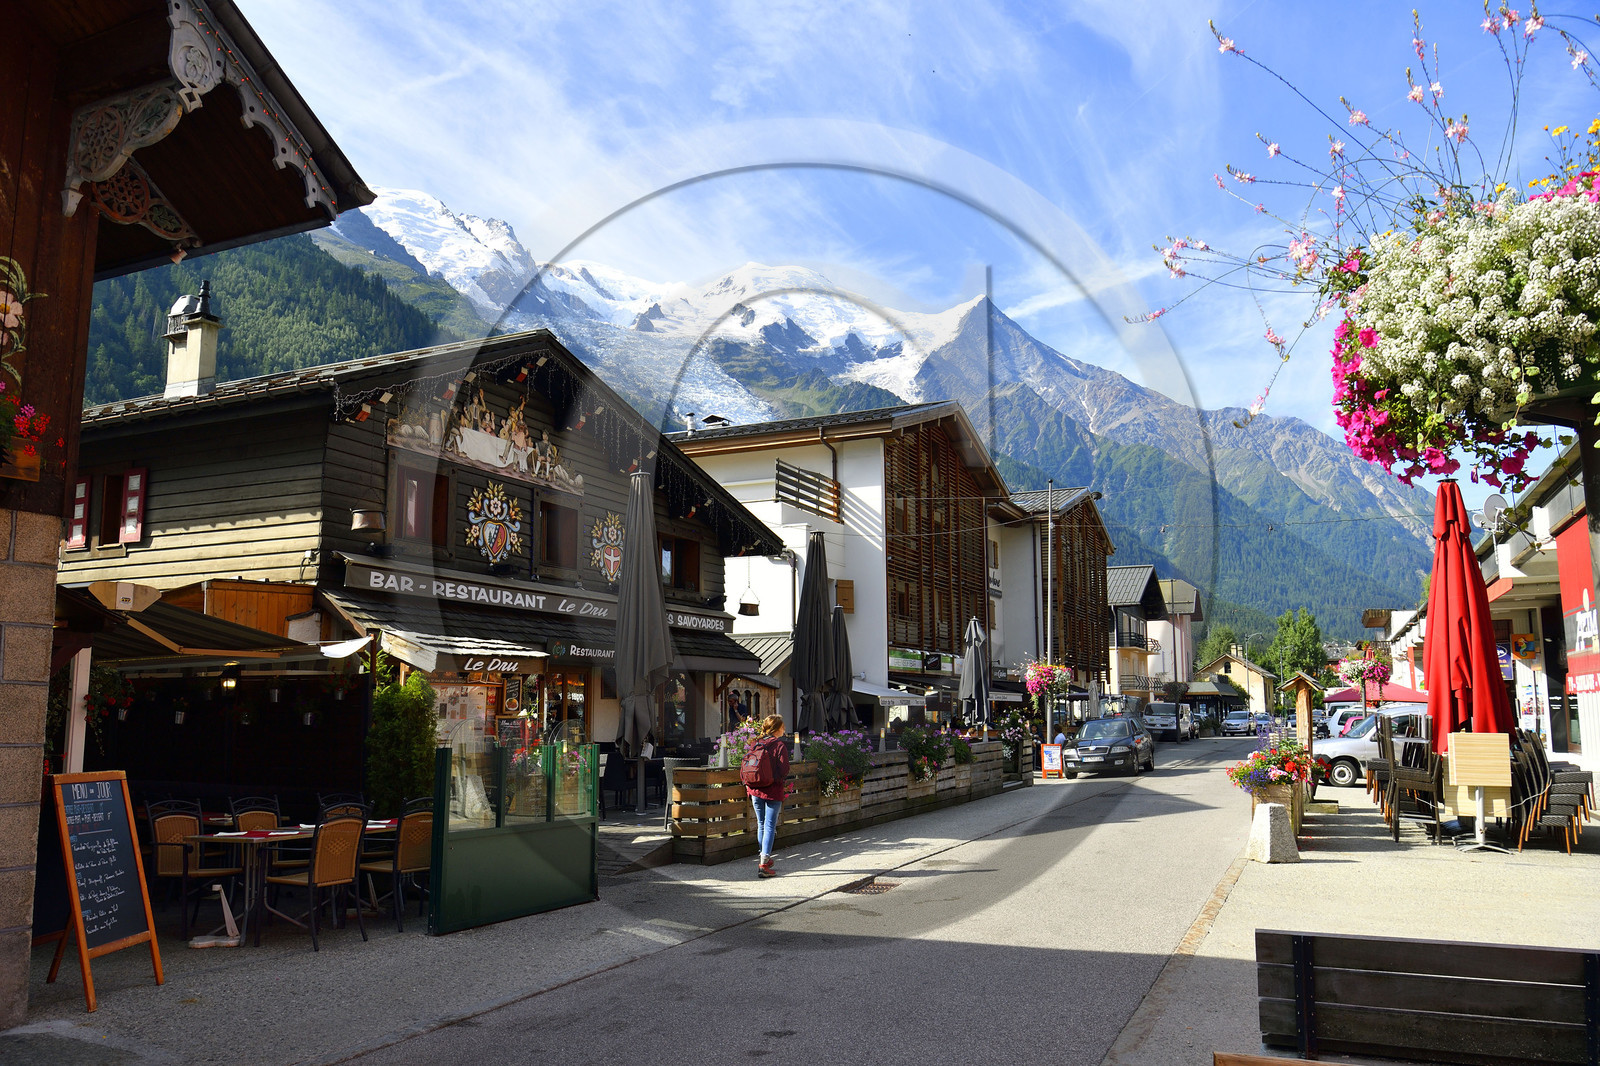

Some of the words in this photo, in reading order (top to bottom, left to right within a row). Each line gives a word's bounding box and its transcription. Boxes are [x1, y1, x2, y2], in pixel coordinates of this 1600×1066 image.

[370, 571, 414, 592] BAR
[432, 580, 546, 609] RESTAURANT
[558, 599, 576, 612] Le
[580, 602, 608, 617] Dru
[678, 614, 724, 630] SAVOYARDES
[570, 644, 615, 658] RESTAURANT
[464, 658, 484, 670] Le
[487, 658, 518, 672] Dru
[72, 784, 88, 800] MENU
[96, 782, 112, 798] JOUR
